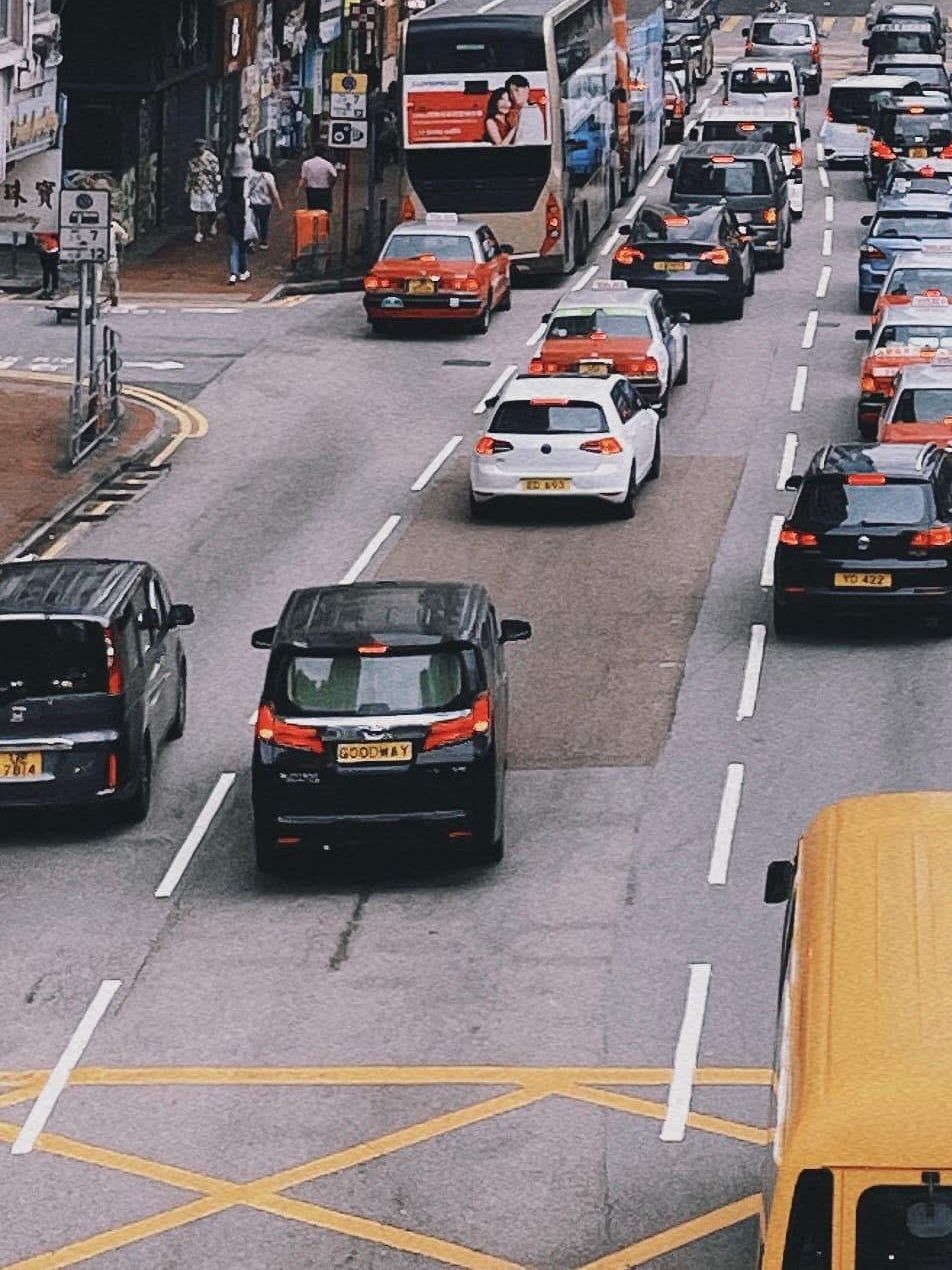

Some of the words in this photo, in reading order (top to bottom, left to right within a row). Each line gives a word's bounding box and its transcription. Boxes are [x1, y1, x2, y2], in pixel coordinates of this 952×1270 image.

[90, 230, 99, 241] 7
[90, 248, 106, 260] 12
[339, 746, 410, 760] GOODWAY
